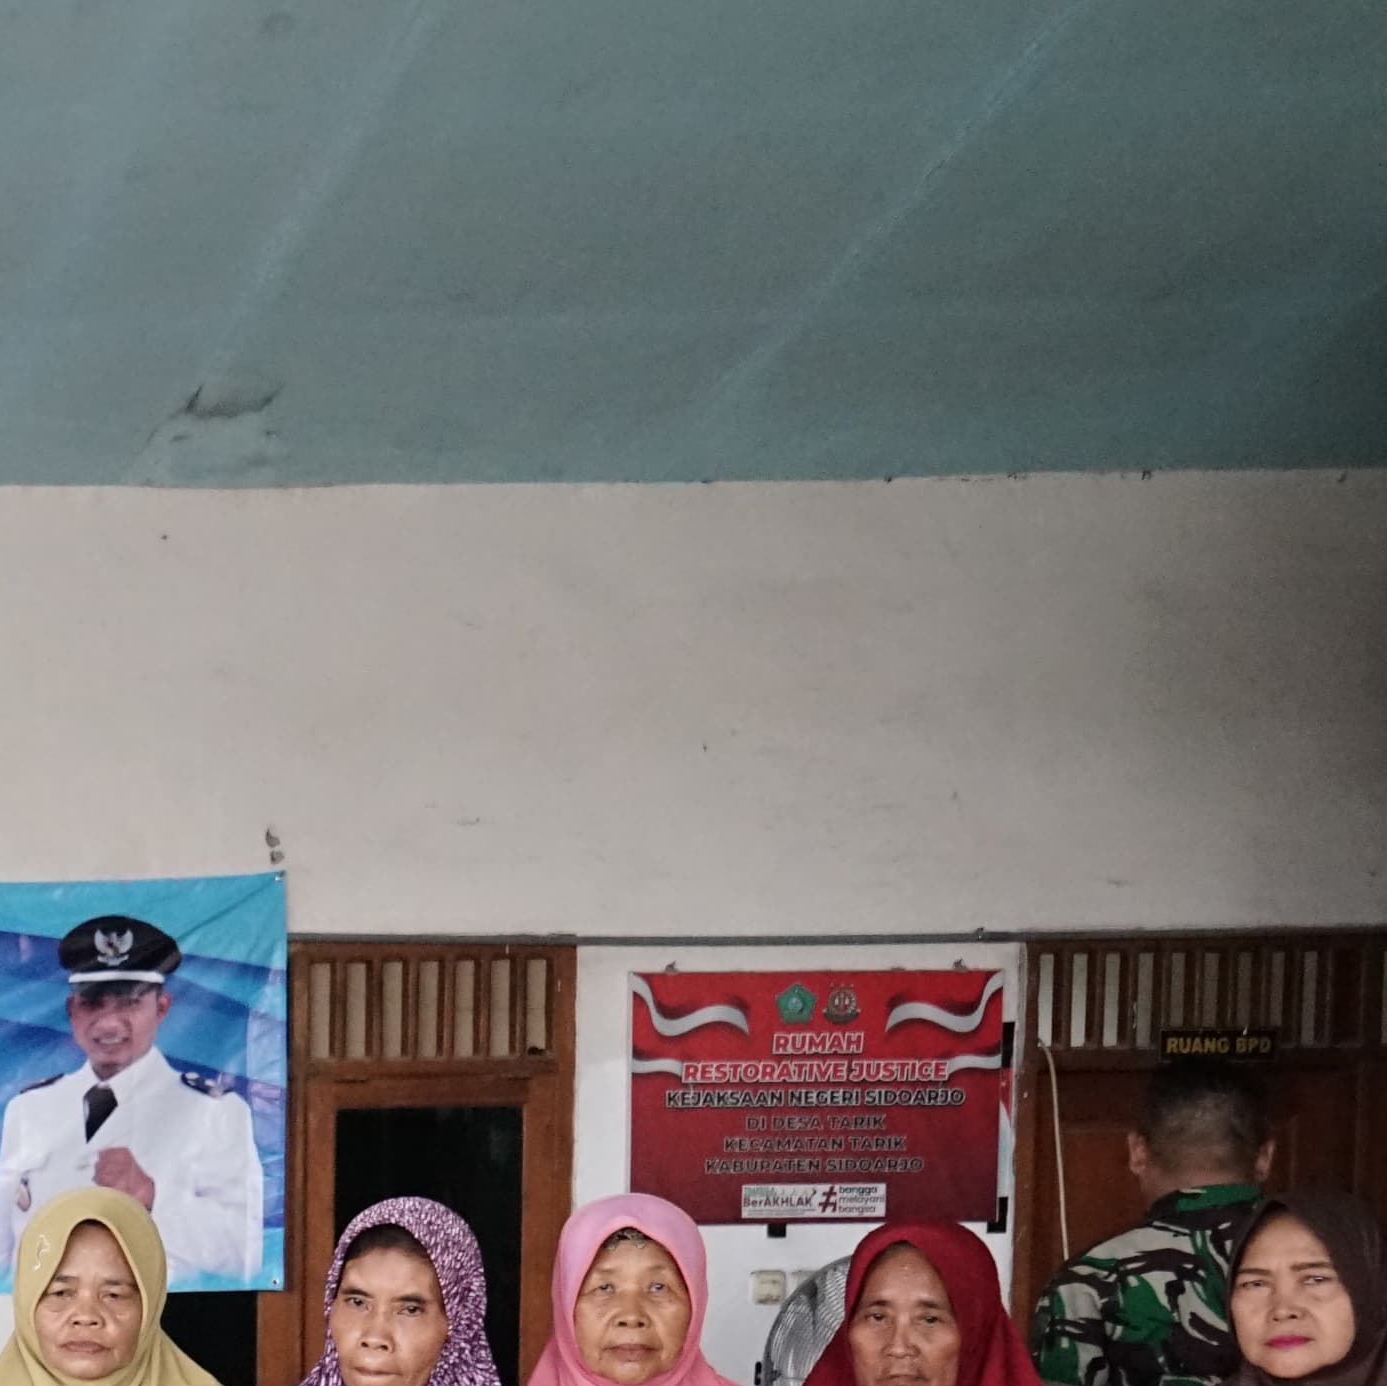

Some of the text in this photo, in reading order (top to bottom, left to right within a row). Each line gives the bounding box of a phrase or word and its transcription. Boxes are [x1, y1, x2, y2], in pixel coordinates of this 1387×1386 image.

[773, 1032, 865, 1055] RUMAH
[1166, 1037, 1272, 1054] RUANG BPD
[682, 1059, 949, 1084] RESTORATIVE JUSTICE
[666, 1087, 966, 1109] KEJAKSAAN NEGERI SIDOARJO
[746, 1114, 886, 1131] DI DESA TARIK
[724, 1135, 907, 1152] KECAMATAN TARIK
[705, 1157, 925, 1174] KABUPATEN SIDOARJO
[839, 1185, 878, 1196] bangga
[743, 1196, 813, 1208] BerAKHLAK
